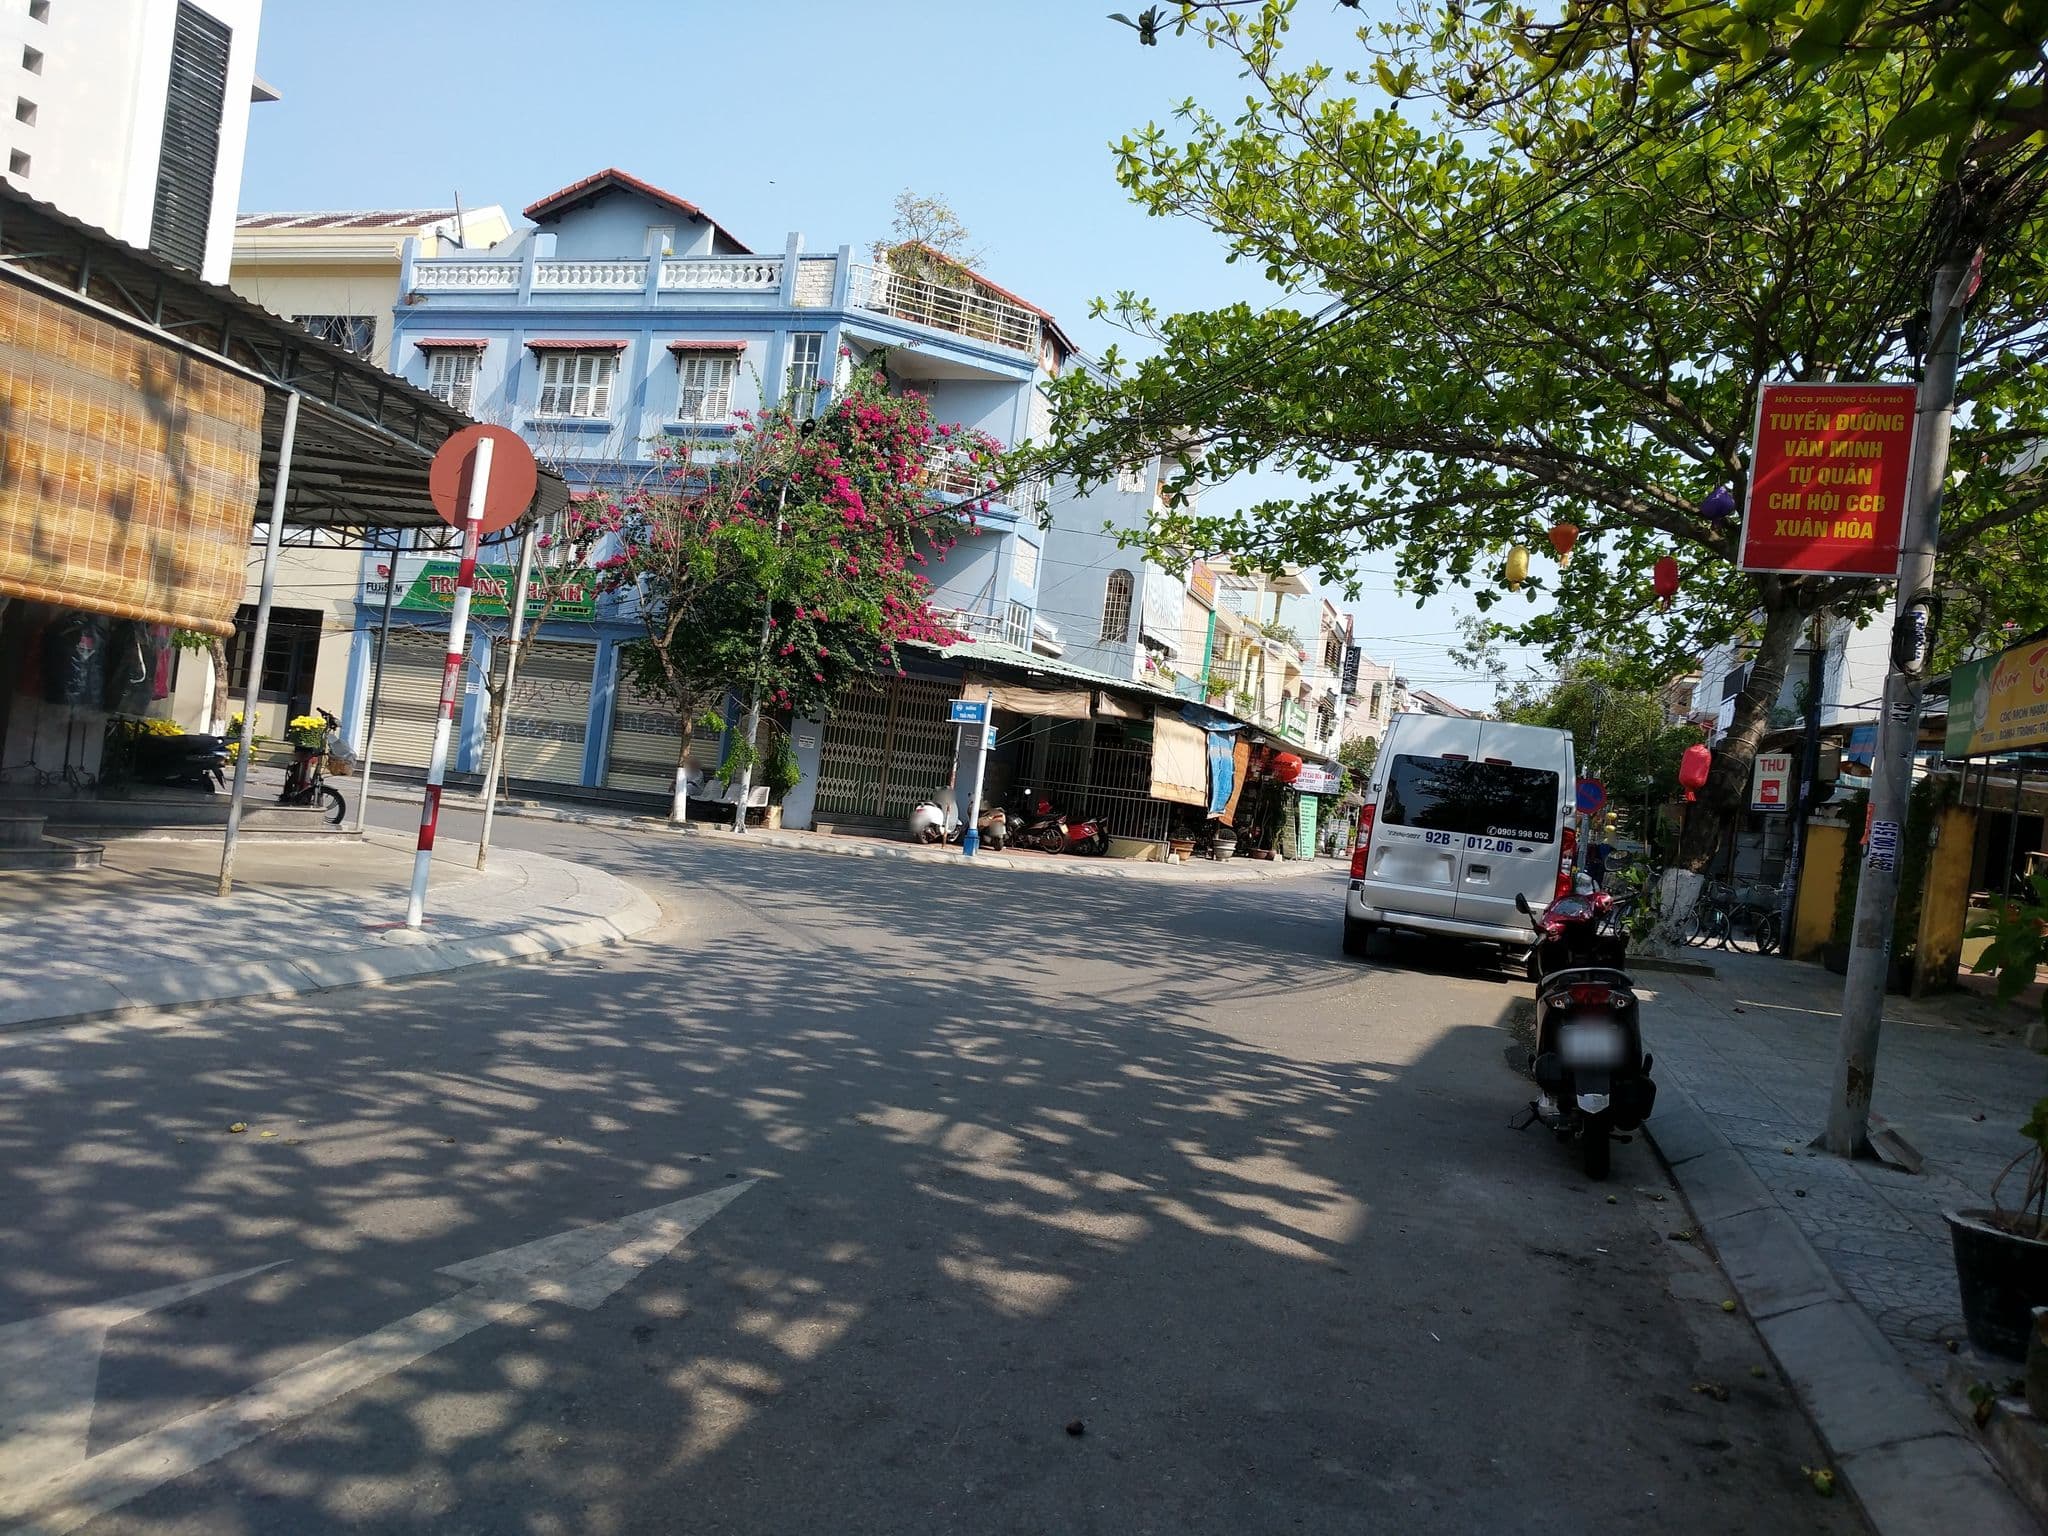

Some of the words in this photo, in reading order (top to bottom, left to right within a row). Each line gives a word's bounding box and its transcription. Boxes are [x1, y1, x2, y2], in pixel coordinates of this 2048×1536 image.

[1794, 396, 1813, 404] CCB
[1769, 408, 1831, 431] TUYẾN
[1835, 410, 1905, 432] ĐƯỜNG
[1784, 436, 1824, 457] VĂN
[1829, 440, 1883, 458] MINH
[1788, 465, 1815, 488] TỰ
[1817, 462, 1873, 486] QUẢN
[1768, 492, 1802, 510] CHI
[1806, 490, 1840, 515] HỘI
[1846, 494, 1886, 513] CCB
[1774, 517, 1829, 538] XUÂN
[1833, 517, 1873, 539] HÒA
[1760, 758, 1786, 772] THU
[1425, 831, 1451, 846] 92B
[1467, 836, 1514, 853] 012.06
[1497, 827, 1517, 837] 0905
[1518, 829, 1533, 838] 998
[1534, 831, 1549, 840] 052
